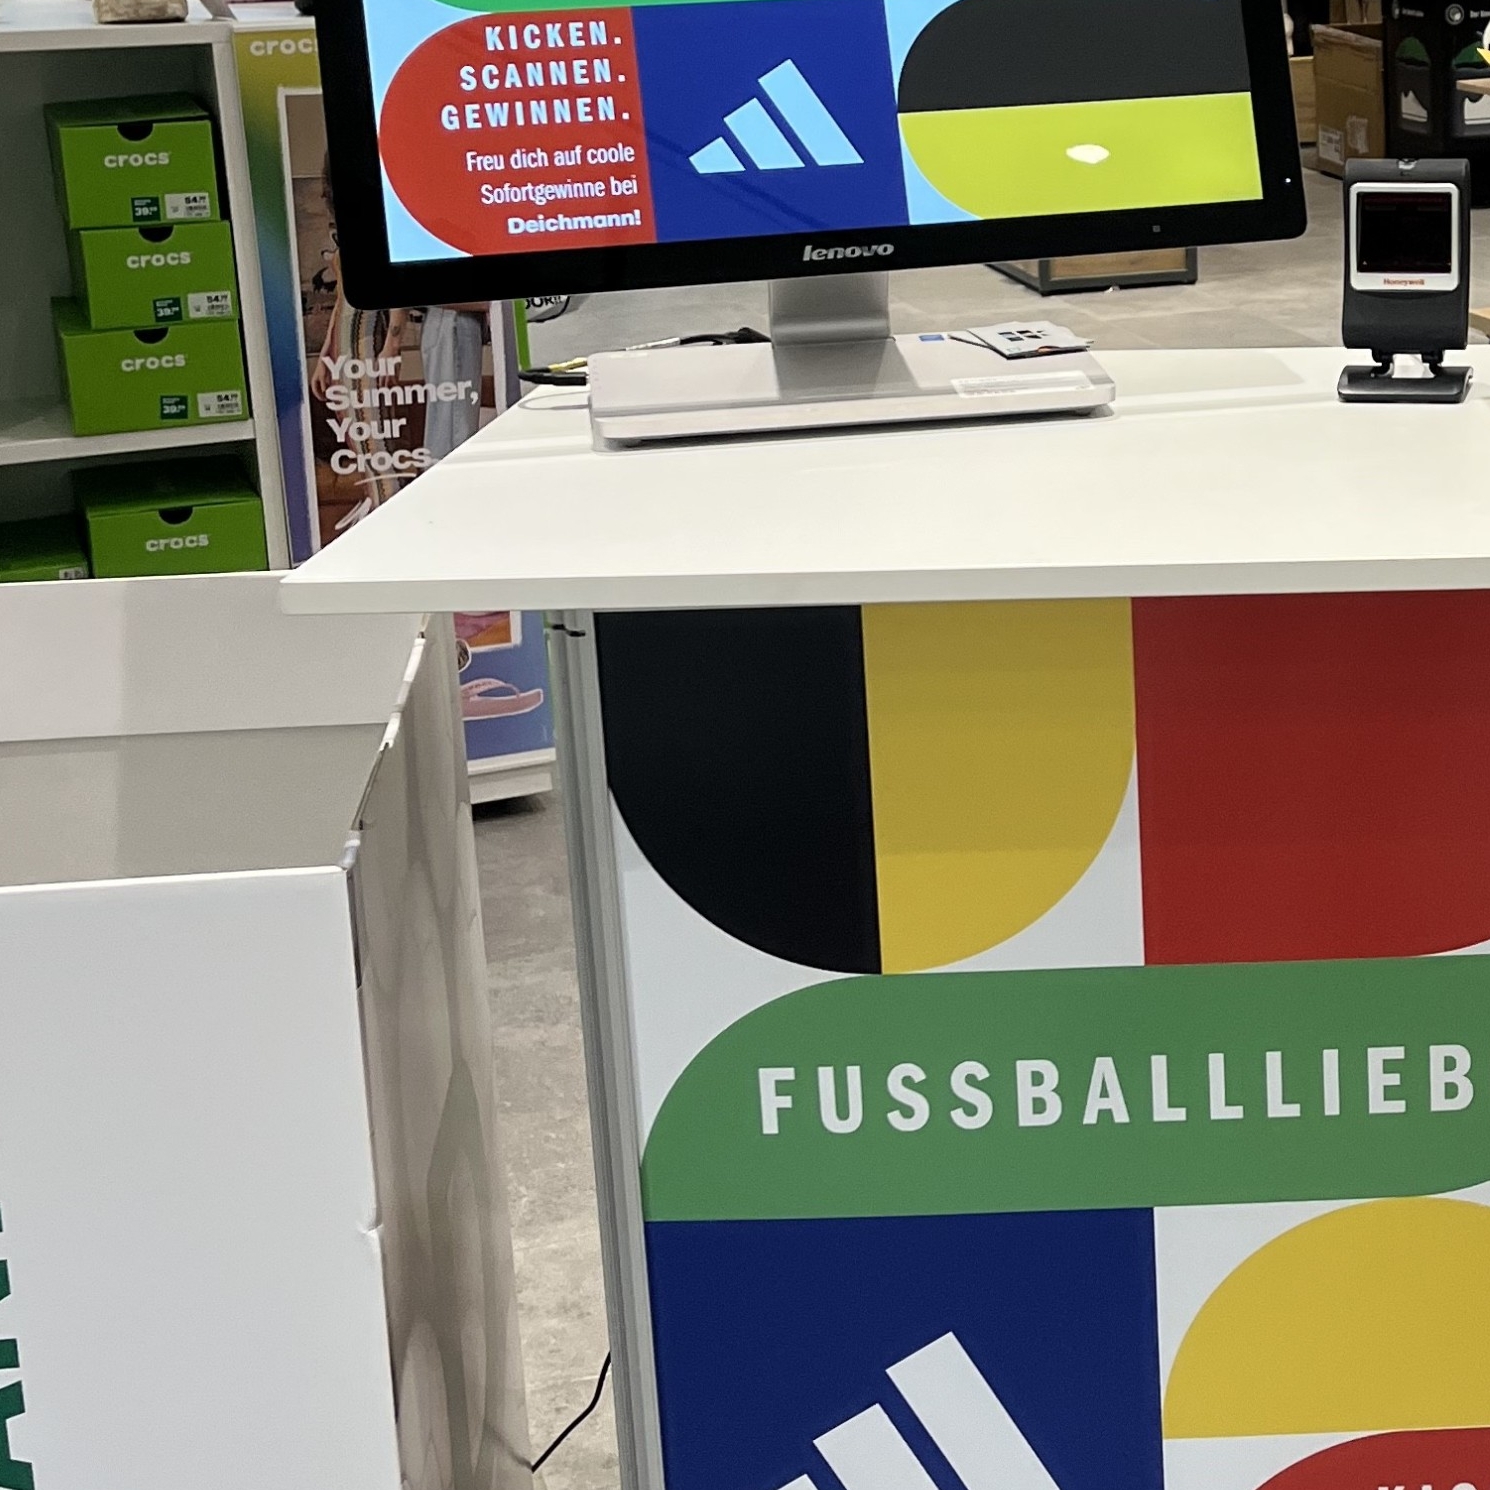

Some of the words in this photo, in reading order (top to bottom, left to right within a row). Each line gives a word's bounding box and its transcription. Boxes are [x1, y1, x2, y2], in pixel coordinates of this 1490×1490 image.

[250, 38, 314, 56] croc
[485, 21, 622, 51] KICKEN.
[460, 58, 626, 91] SCANNEN.
[441, 96, 630, 130] GEWINNEN.
[104, 152, 170, 168] crocs
[466, 151, 505, 172] Freu
[510, 148, 549, 169] dich
[554, 145, 582, 166] auf
[587, 142, 635, 164] coole
[481, 179, 606, 205] Sofortgewinne
[610, 175, 638, 196] bei
[508, 209, 641, 234] Deichmann!
[126, 252, 191, 269] crocs
[803, 242, 895, 262] lenovo
[1383, 278, 1425, 287] Honeywell
[121, 354, 186, 372] crocs
[321, 356, 402, 380] Your
[325, 380, 479, 411] Summer,
[326, 417, 407, 443] Your
[146, 534, 209, 552] crocs
